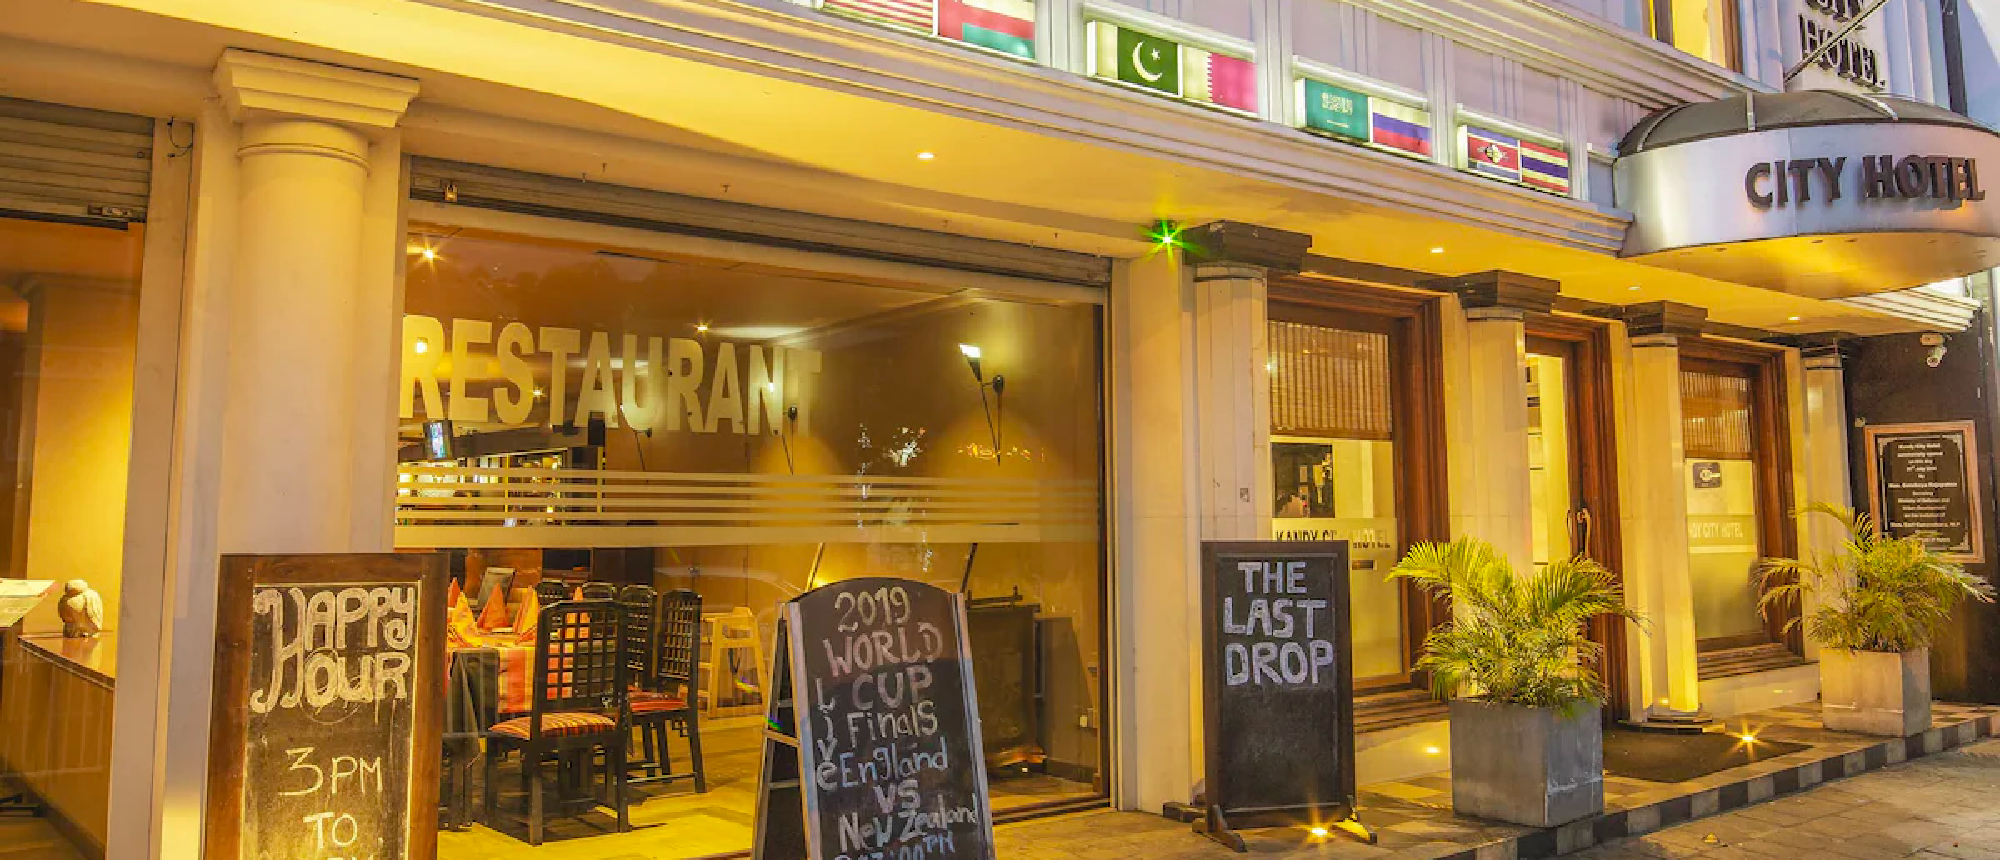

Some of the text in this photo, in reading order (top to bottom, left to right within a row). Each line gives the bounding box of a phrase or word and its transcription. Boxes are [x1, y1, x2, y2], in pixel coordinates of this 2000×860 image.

[1745, 154, 1986, 209] CITY HOTEL
[399, 314, 823, 438] RESTAURANT
[1237, 561, 1308, 594] THE
[834, 586, 912, 633] 2019
[1223, 596, 1328, 639] LAST
[822, 621, 943, 678] WORLD
[1225, 639, 1334, 686] DROP
[852, 664, 934, 711] CUP
[277, 746, 384, 796] 3 PM
[839, 731, 949, 789] England
[302, 811, 359, 850] TO
